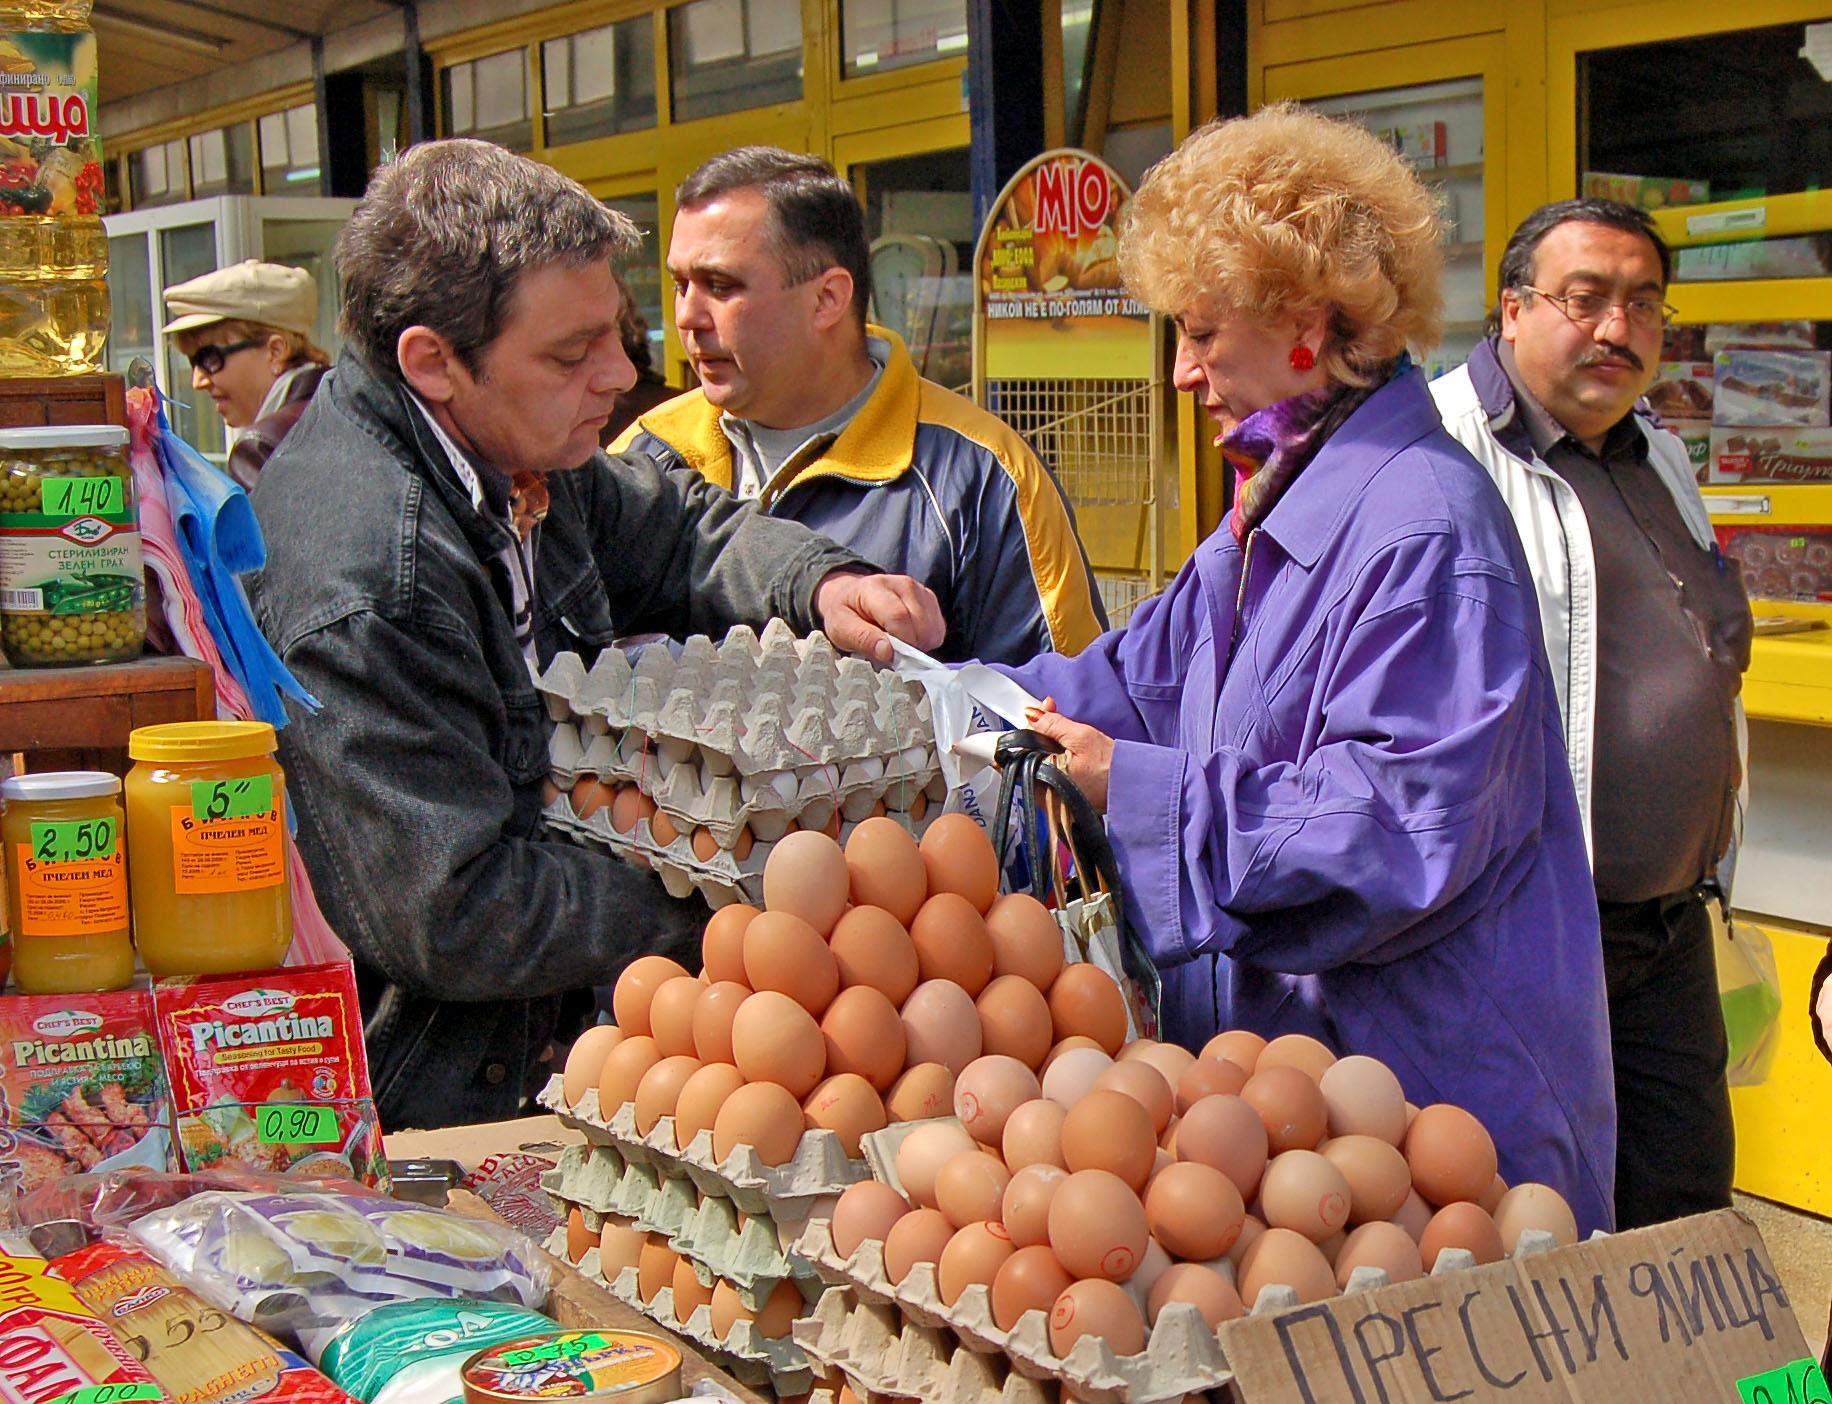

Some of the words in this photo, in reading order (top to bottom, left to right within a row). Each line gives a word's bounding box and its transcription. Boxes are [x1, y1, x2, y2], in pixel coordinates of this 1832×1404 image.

[1049, 299, 1102, 317] ПО-ГОЛЯМ
[1104, 298, 1119, 315] ОТ
[48, 546, 129, 559] СТЕРИЛИЗИРАН
[58, 561, 95, 571] ЗЕЛЕН
[100, 558, 125, 569] ГРАХ
[200, 829, 246, 841] ПЧЕЛЕН
[248, 826, 268, 836] МЕД
[43, 870, 90, 882] ПЧЕЛЕН
[93, 869, 113, 879] МЕД
[264, 995, 291, 1006] BEST
[73, 1016, 98, 1027] BEST
[190, 1012, 334, 1052] Picantina
[13, 1033, 151, 1068] Picantina
[222, 1050, 263, 1061] Seasoning
[264, 1048, 275, 1057] for
[297, 1044, 317, 1053] Food
[265, 1109, 320, 1141] 0,90
[1273, 1274, 1629, 1404] ПРЕСНИ
[1629, 1247, 1789, 1345] ЯЙЦА
